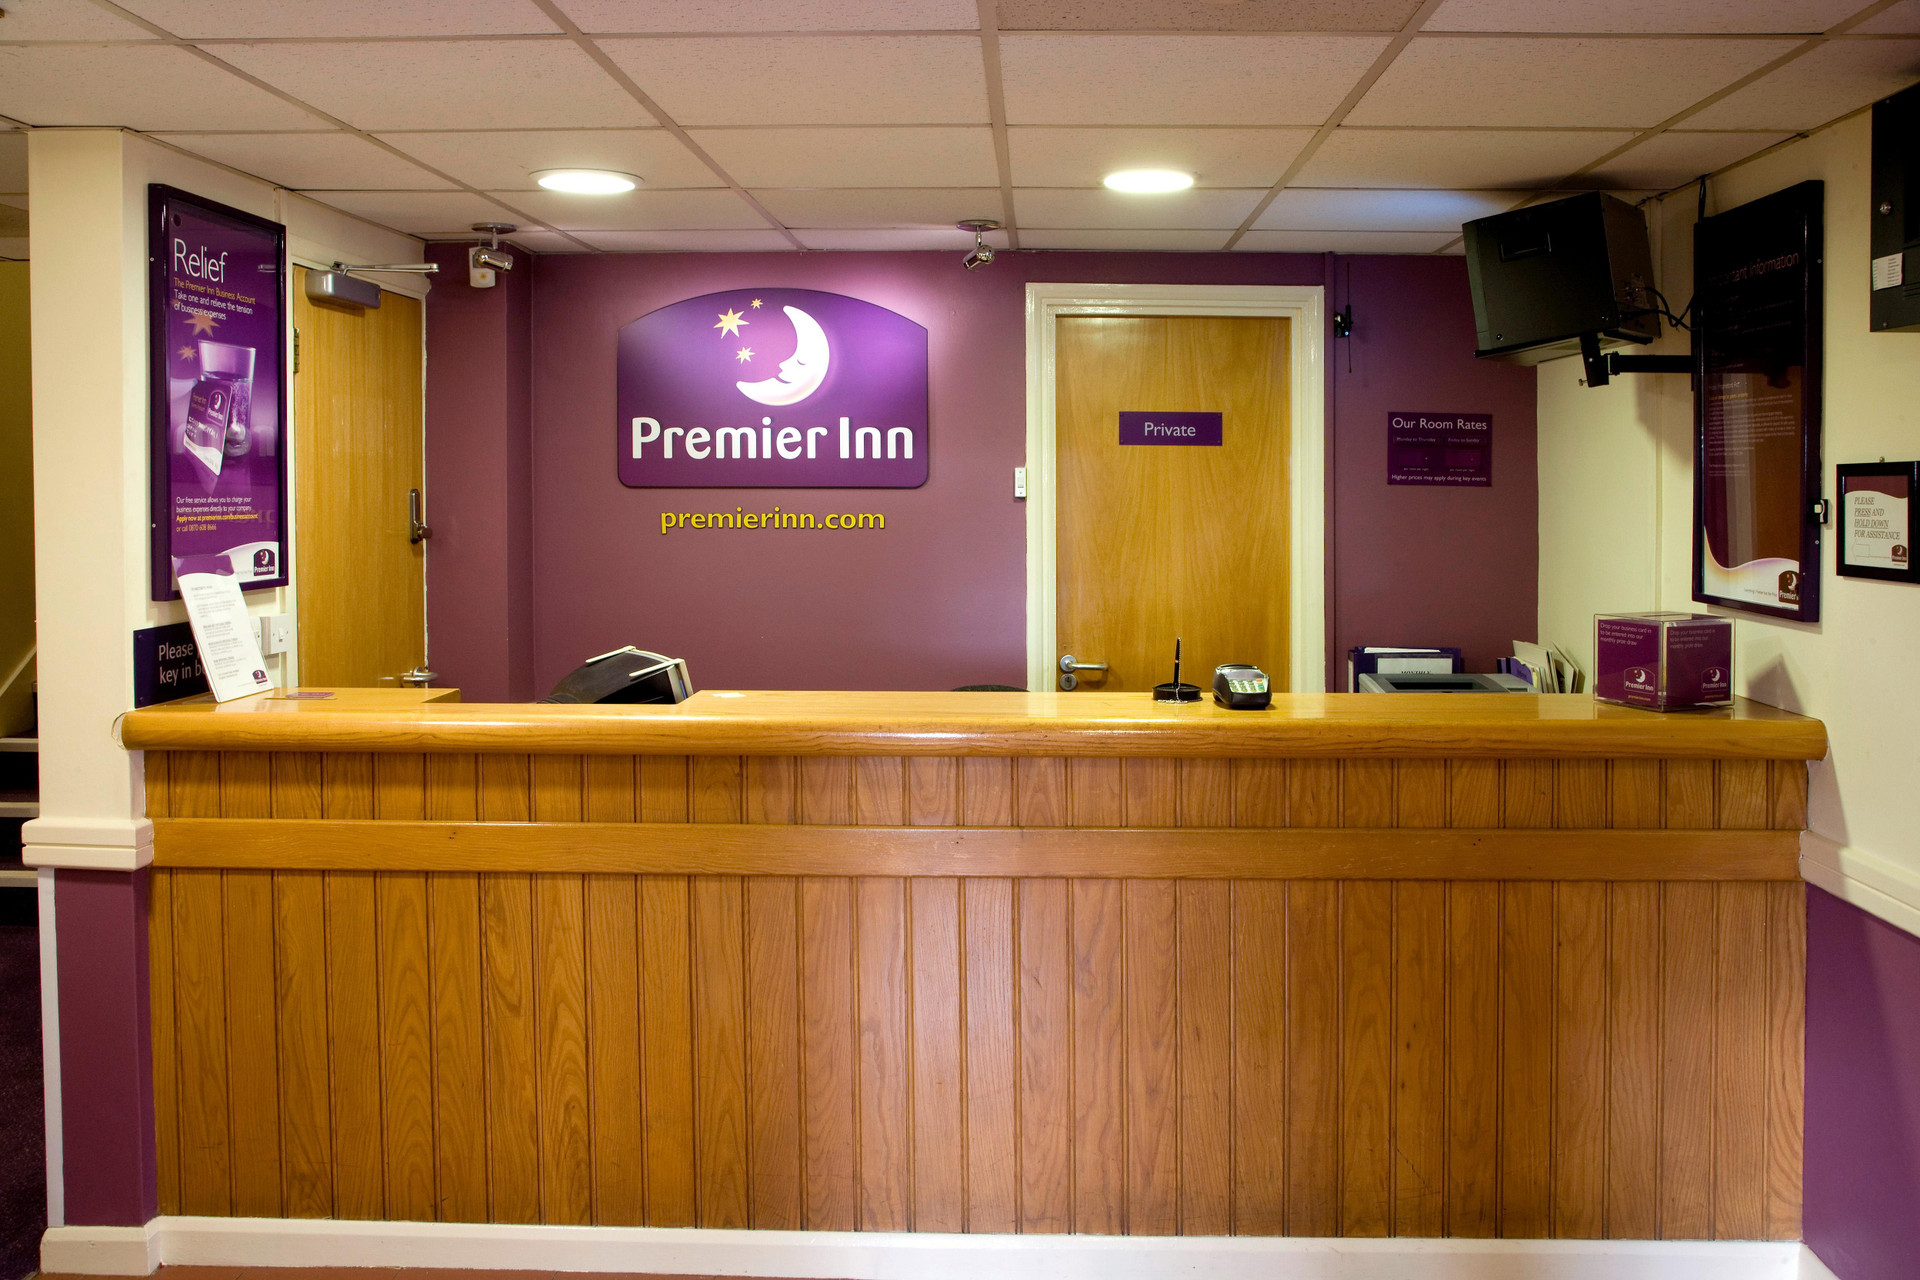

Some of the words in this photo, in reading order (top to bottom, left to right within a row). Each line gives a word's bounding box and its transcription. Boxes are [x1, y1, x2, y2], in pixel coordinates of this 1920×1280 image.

[175, 238, 228, 283] Relief
[174, 277, 184, 288] The
[186, 280, 206, 293] Premier
[206, 285, 215, 295] Inn
[216, 287, 235, 300] Business
[236, 293, 256, 305] Account
[174, 289, 187, 300] Take
[188, 295, 199, 304] one
[200, 297, 210, 306] and
[211, 299, 226, 309] relieve
[227, 302, 236, 311] the
[236, 304, 253, 314] tension
[174, 301, 181, 311] of
[181, 303, 203, 315] business
[204, 309, 226, 320] expenses
[1144, 422, 1196, 437] Private
[1392, 418, 1416, 428] Our
[1420, 418, 1453, 429] Room
[1457, 419, 1487, 430] Rates
[632, 416, 828, 460] Premier
[839, 416, 913, 460] Inn
[1854, 497, 1875, 505] PLEASE
[660, 506, 886, 535] premierinn.com
[1854, 508, 1871, 517] PRESS
[1872, 508, 1884, 516] AND
[1854, 519, 1870, 528] HOLD
[1871, 520, 1889, 529] DOWN
[1866, 531, 1900, 540] ASSISTANCE
[1780, 590, 1796, 600] Premier
[159, 642, 194, 661] Please
[160, 666, 178, 686] key
[182, 663, 191, 679] in
[1626, 681, 1645, 690] Premier
